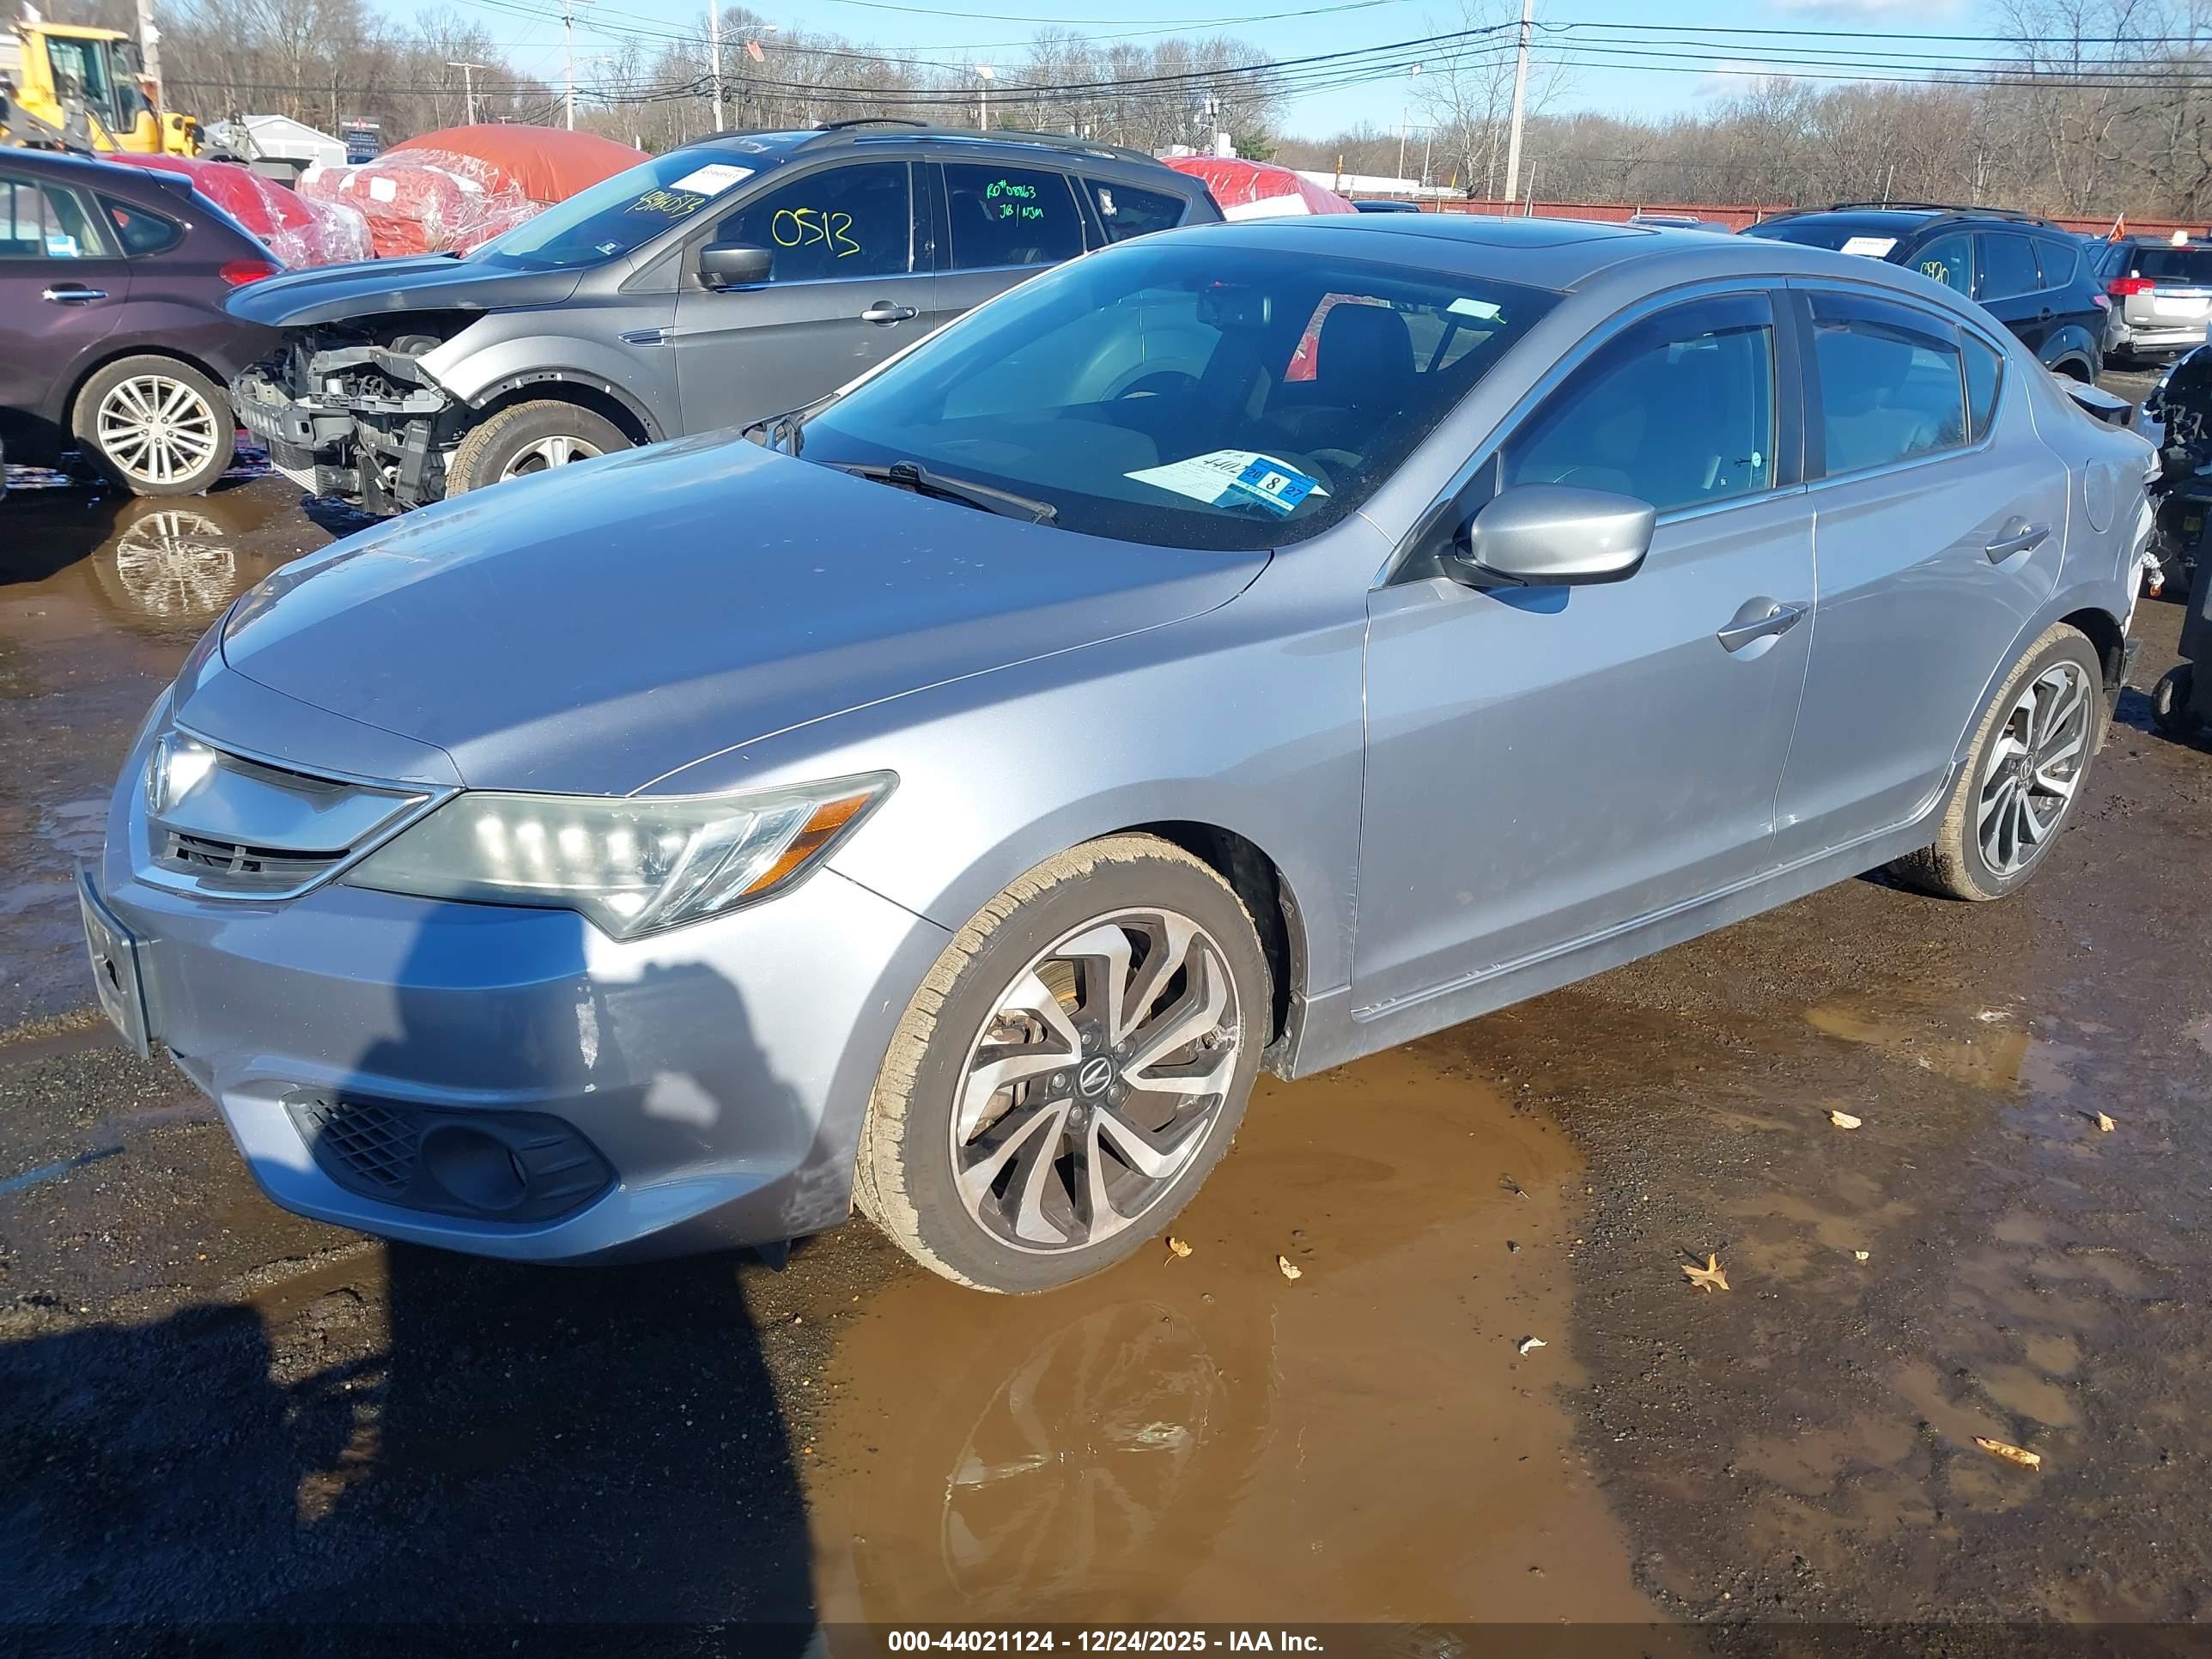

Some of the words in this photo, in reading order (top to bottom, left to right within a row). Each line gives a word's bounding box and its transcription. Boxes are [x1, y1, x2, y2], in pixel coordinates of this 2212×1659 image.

[772, 208, 860, 258] 0513
[1266, 477, 1281, 490] 8
[1284, 486, 1305, 498] 27
